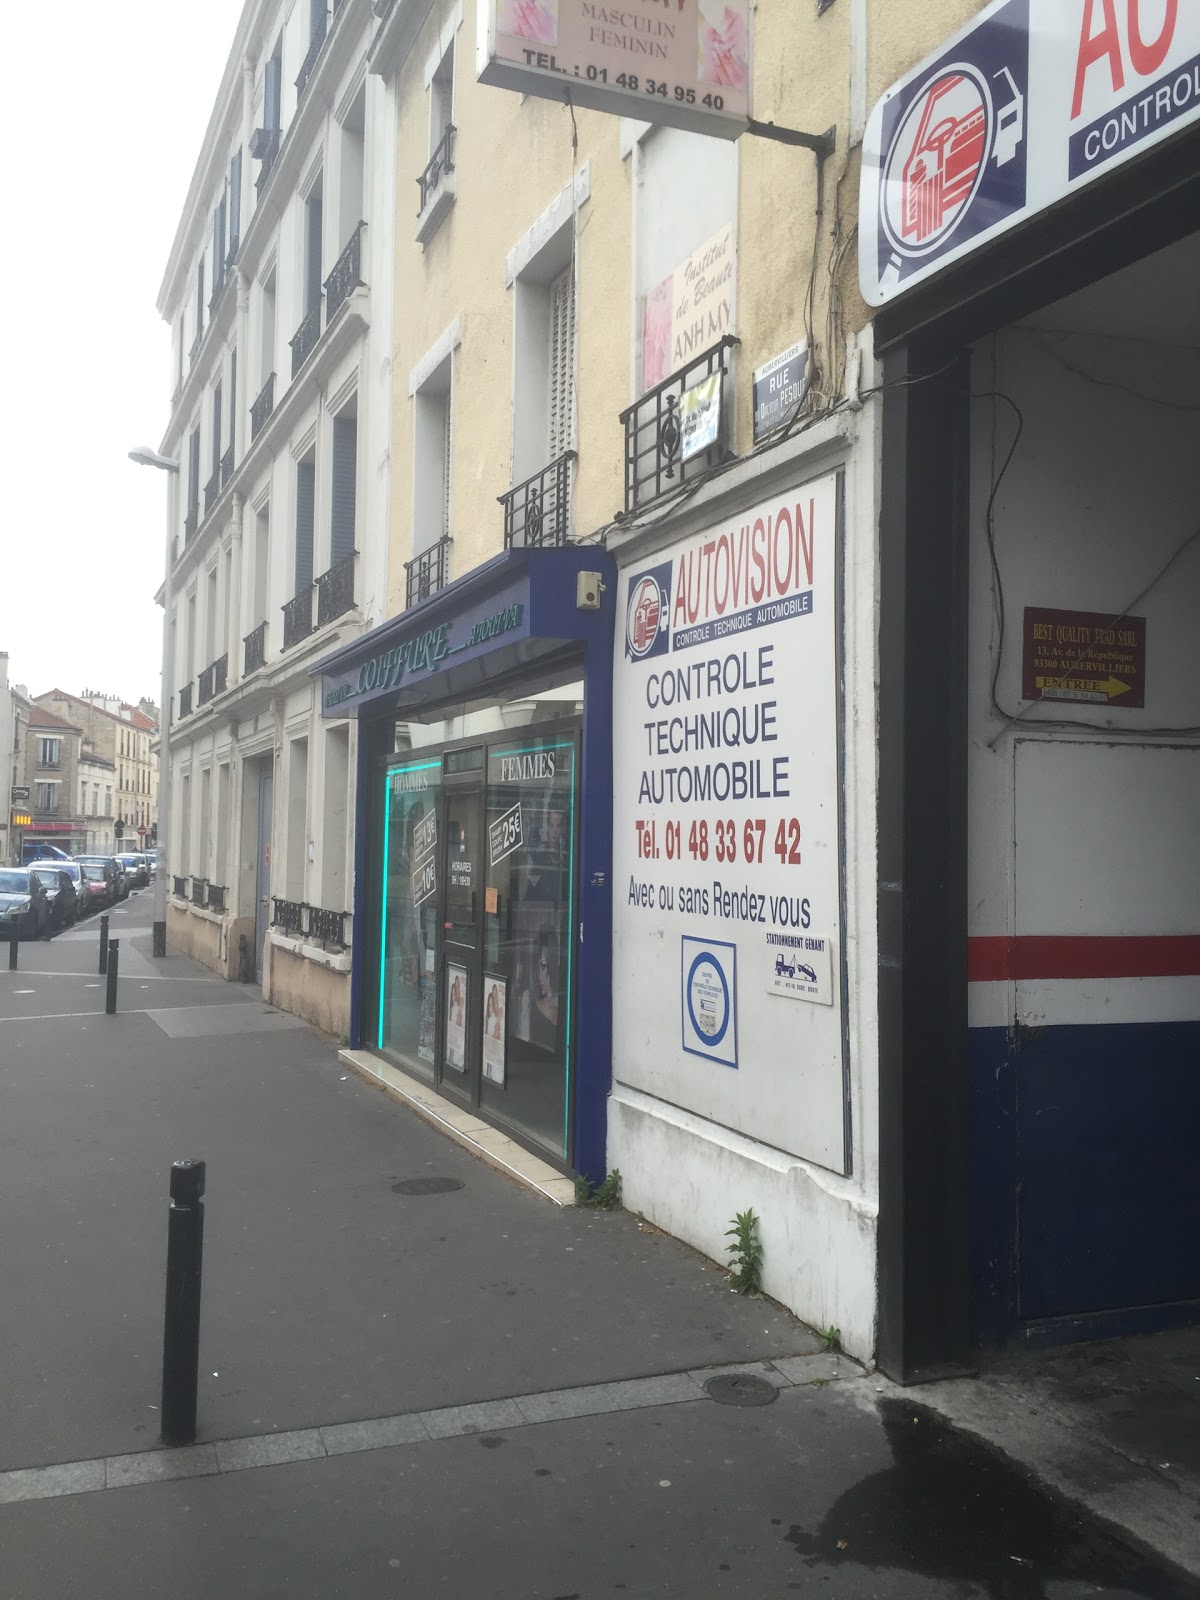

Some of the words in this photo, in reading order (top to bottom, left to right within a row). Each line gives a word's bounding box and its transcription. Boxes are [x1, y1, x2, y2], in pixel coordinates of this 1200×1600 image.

[582, 3, 675, 39] MASCULIN
[590, 27, 667, 59] FEMININ
[586, 65, 608, 84] 01
[616, 73, 639, 90] 48
[646, 80, 668, 97] 34
[674, 86, 696, 104] 95
[702, 94, 724, 110] 40
[684, 232, 730, 286] Institut
[762, 345, 799, 376] AUBERVILLIERS
[769, 368, 790, 394] RUE
[672, 498, 814, 628] AUTOVISION
[676, 625, 710, 648] CONTROLE
[714, 613, 752, 636] TECHNIQUE
[756, 596, 808, 624] AUTOMOBILE
[1033, 624, 1054, 640] BEST
[1056, 625, 1092, 644] QUALITY
[356, 622, 449, 693] COIFFURE
[1034, 658, 1058, 668] 93300
[1060, 660, 1136, 674] AUBERVILLIERS
[1066, 648, 1076, 657] de
[646, 644, 774, 708] CONTROLE
[644, 700, 778, 756] TECHNIQUE
[394, 771, 428, 794] HOMMES
[500, 752, 555, 782] FEMMES
[638, 756, 790, 804] AUTOMOBILE
[422, 816, 436, 846] 13€
[502, 812, 520, 848] 25€
[636, 819, 660, 860] Tél.
[666, 820, 680, 860] 01
[688, 819, 708, 862] 48
[716, 819, 736, 863] 33
[744, 818, 766, 864] 67
[774, 818, 802, 864] 42
[422, 863, 435, 892] 10€
[452, 860, 472, 873] HORAIRES
[628, 874, 654, 908] Avec
[658, 885, 674, 910] ou
[678, 885, 709, 916] sans
[713, 881, 766, 922] Rendez
[770, 894, 811, 928] vous
[766, 932, 804, 949] STATIONNEMENT
